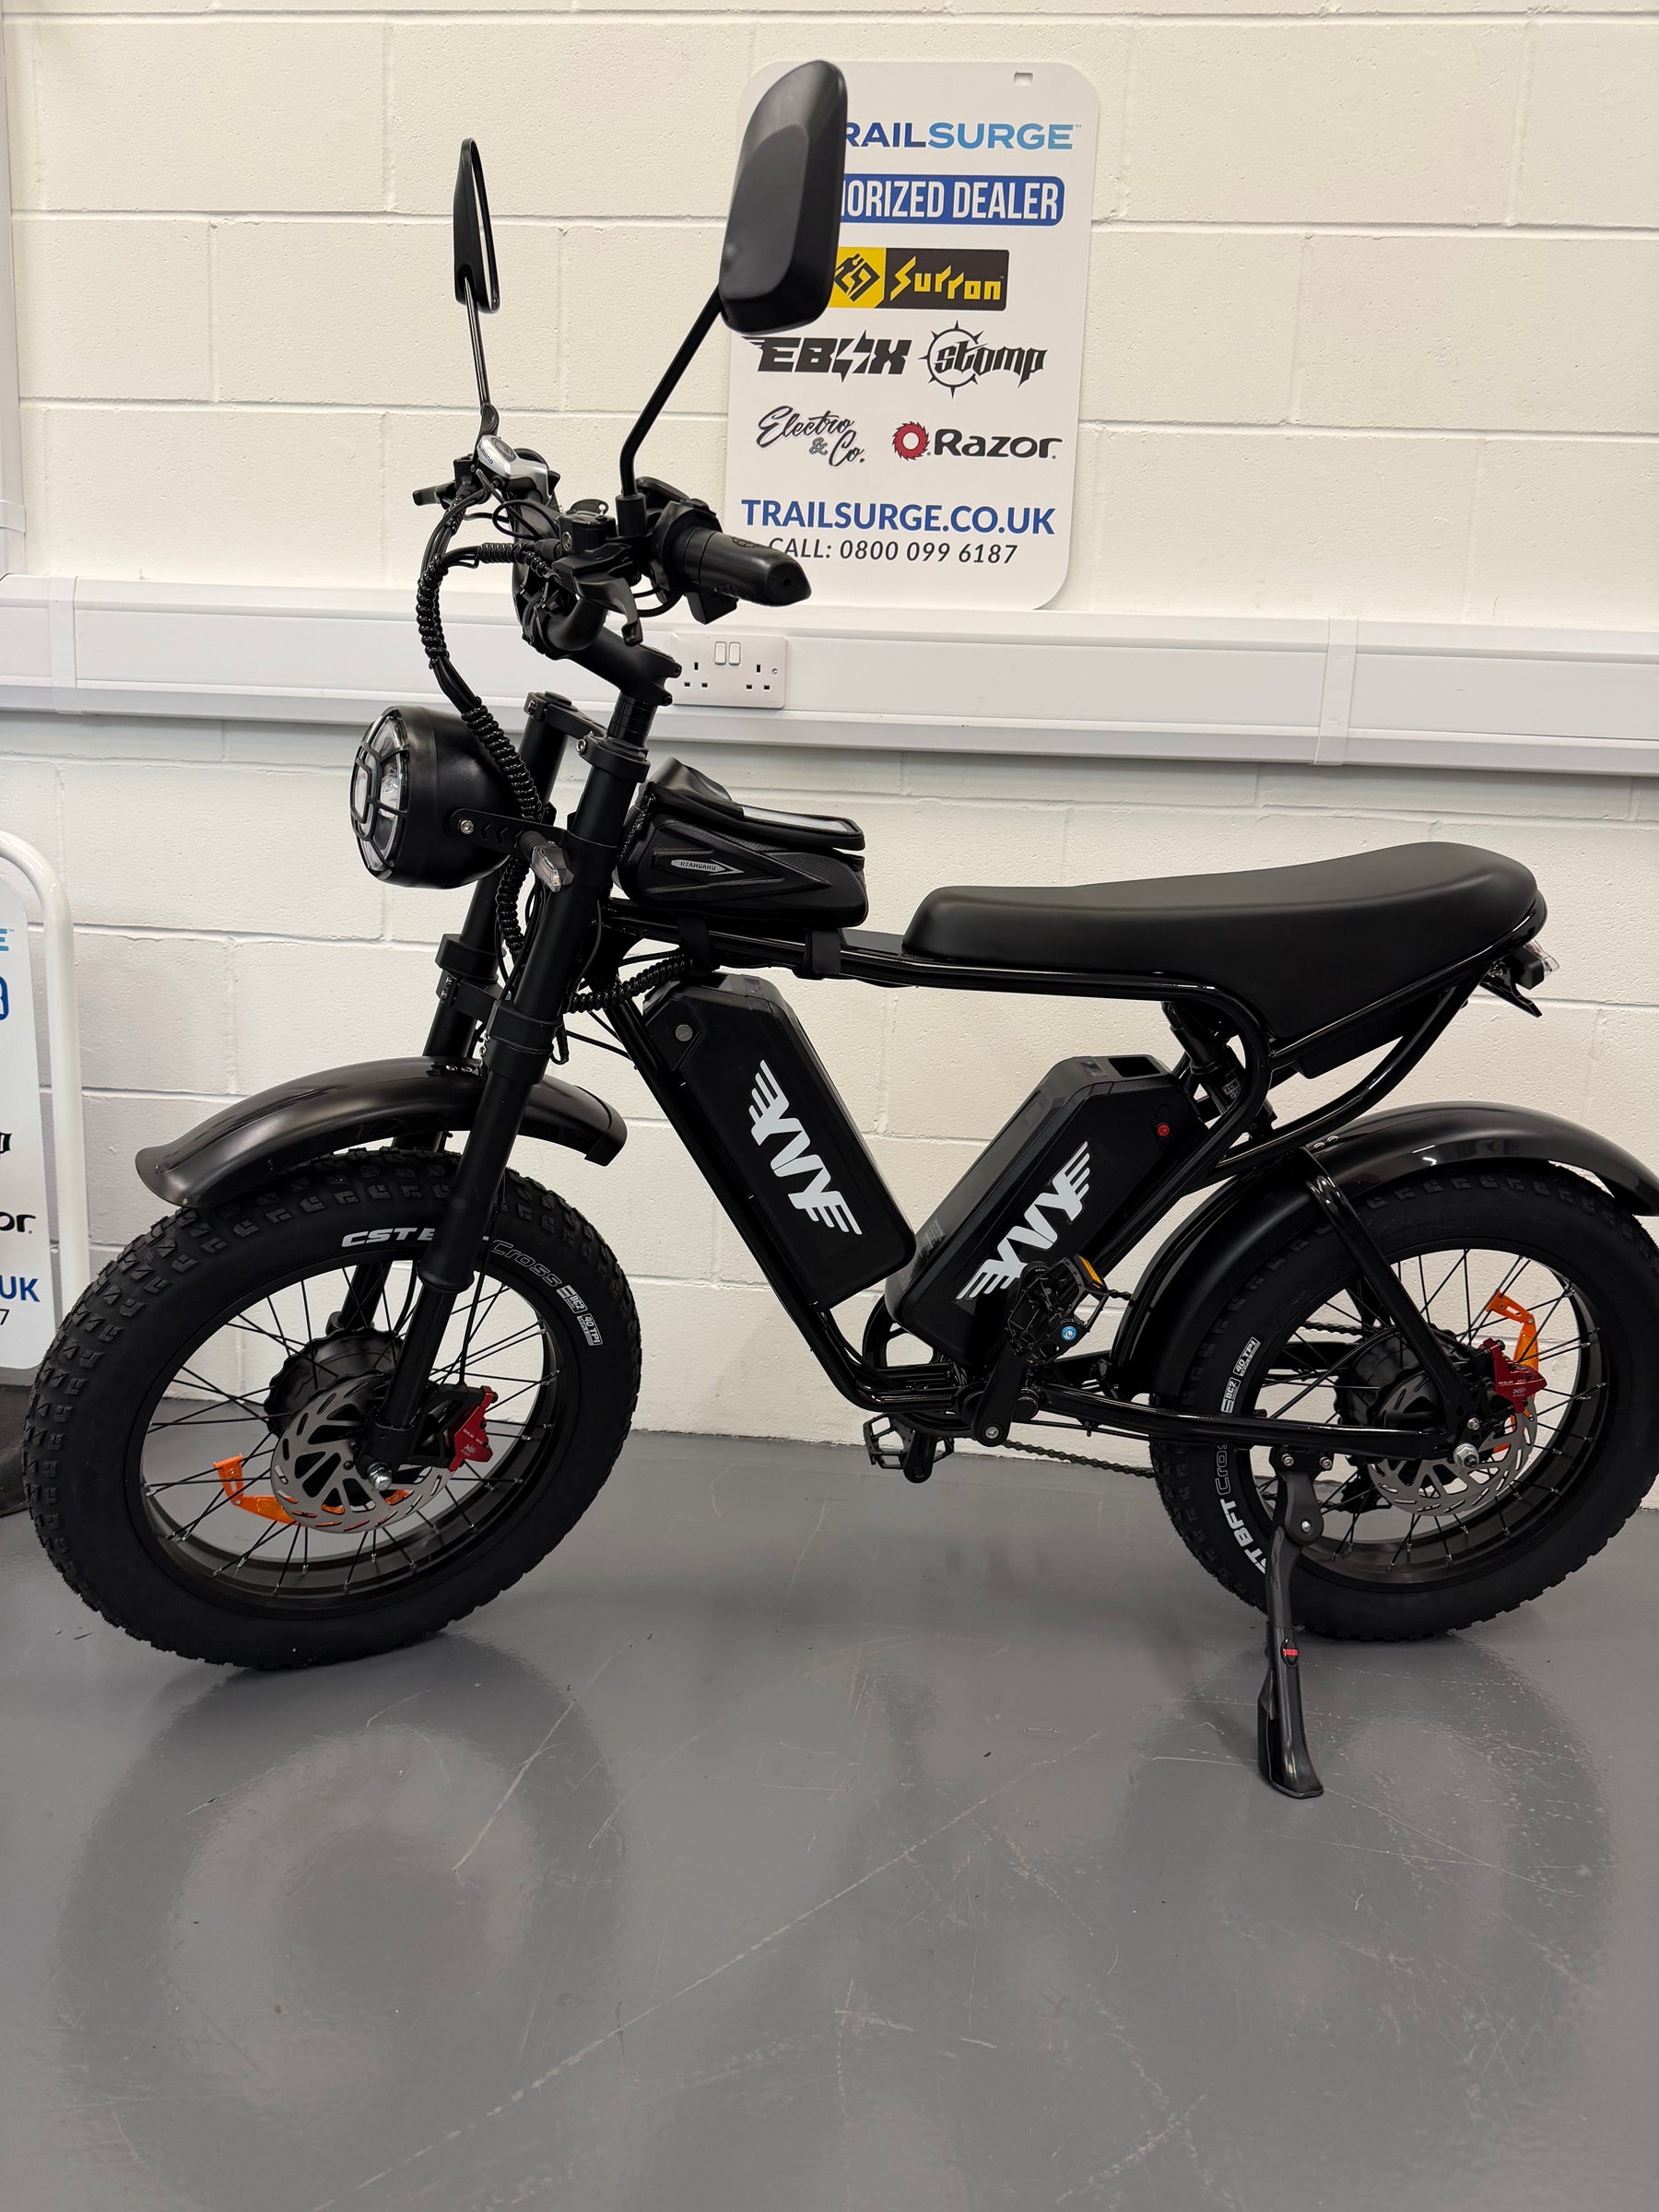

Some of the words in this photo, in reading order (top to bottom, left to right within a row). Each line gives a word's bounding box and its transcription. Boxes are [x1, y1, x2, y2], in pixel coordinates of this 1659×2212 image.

[846, 122, 1074, 149] RAILSURGE
[841, 180, 945, 218] ORIZED
[952, 181, 1059, 220] DEALER
[756, 406, 856, 447] Electro
[809, 437, 828, 456] &
[829, 431, 865, 467] Co.
[741, 499, 1056, 535] TRAILSURGE.CO.UK
[769, 537, 832, 559] CALL:
[840, 538, 899, 561] 0800
[906, 541, 950, 563] 099
[959, 543, 1018, 564] 6187
[340, 1227, 418, 1248] CST
[490, 1239, 563, 1288] Cross
[589, 1327, 601, 1343] TPI
[1241, 1339, 1256, 1359] TPI
[1215, 1443, 1231, 1496] Cro
[1220, 1498, 1254, 1547] BFT
